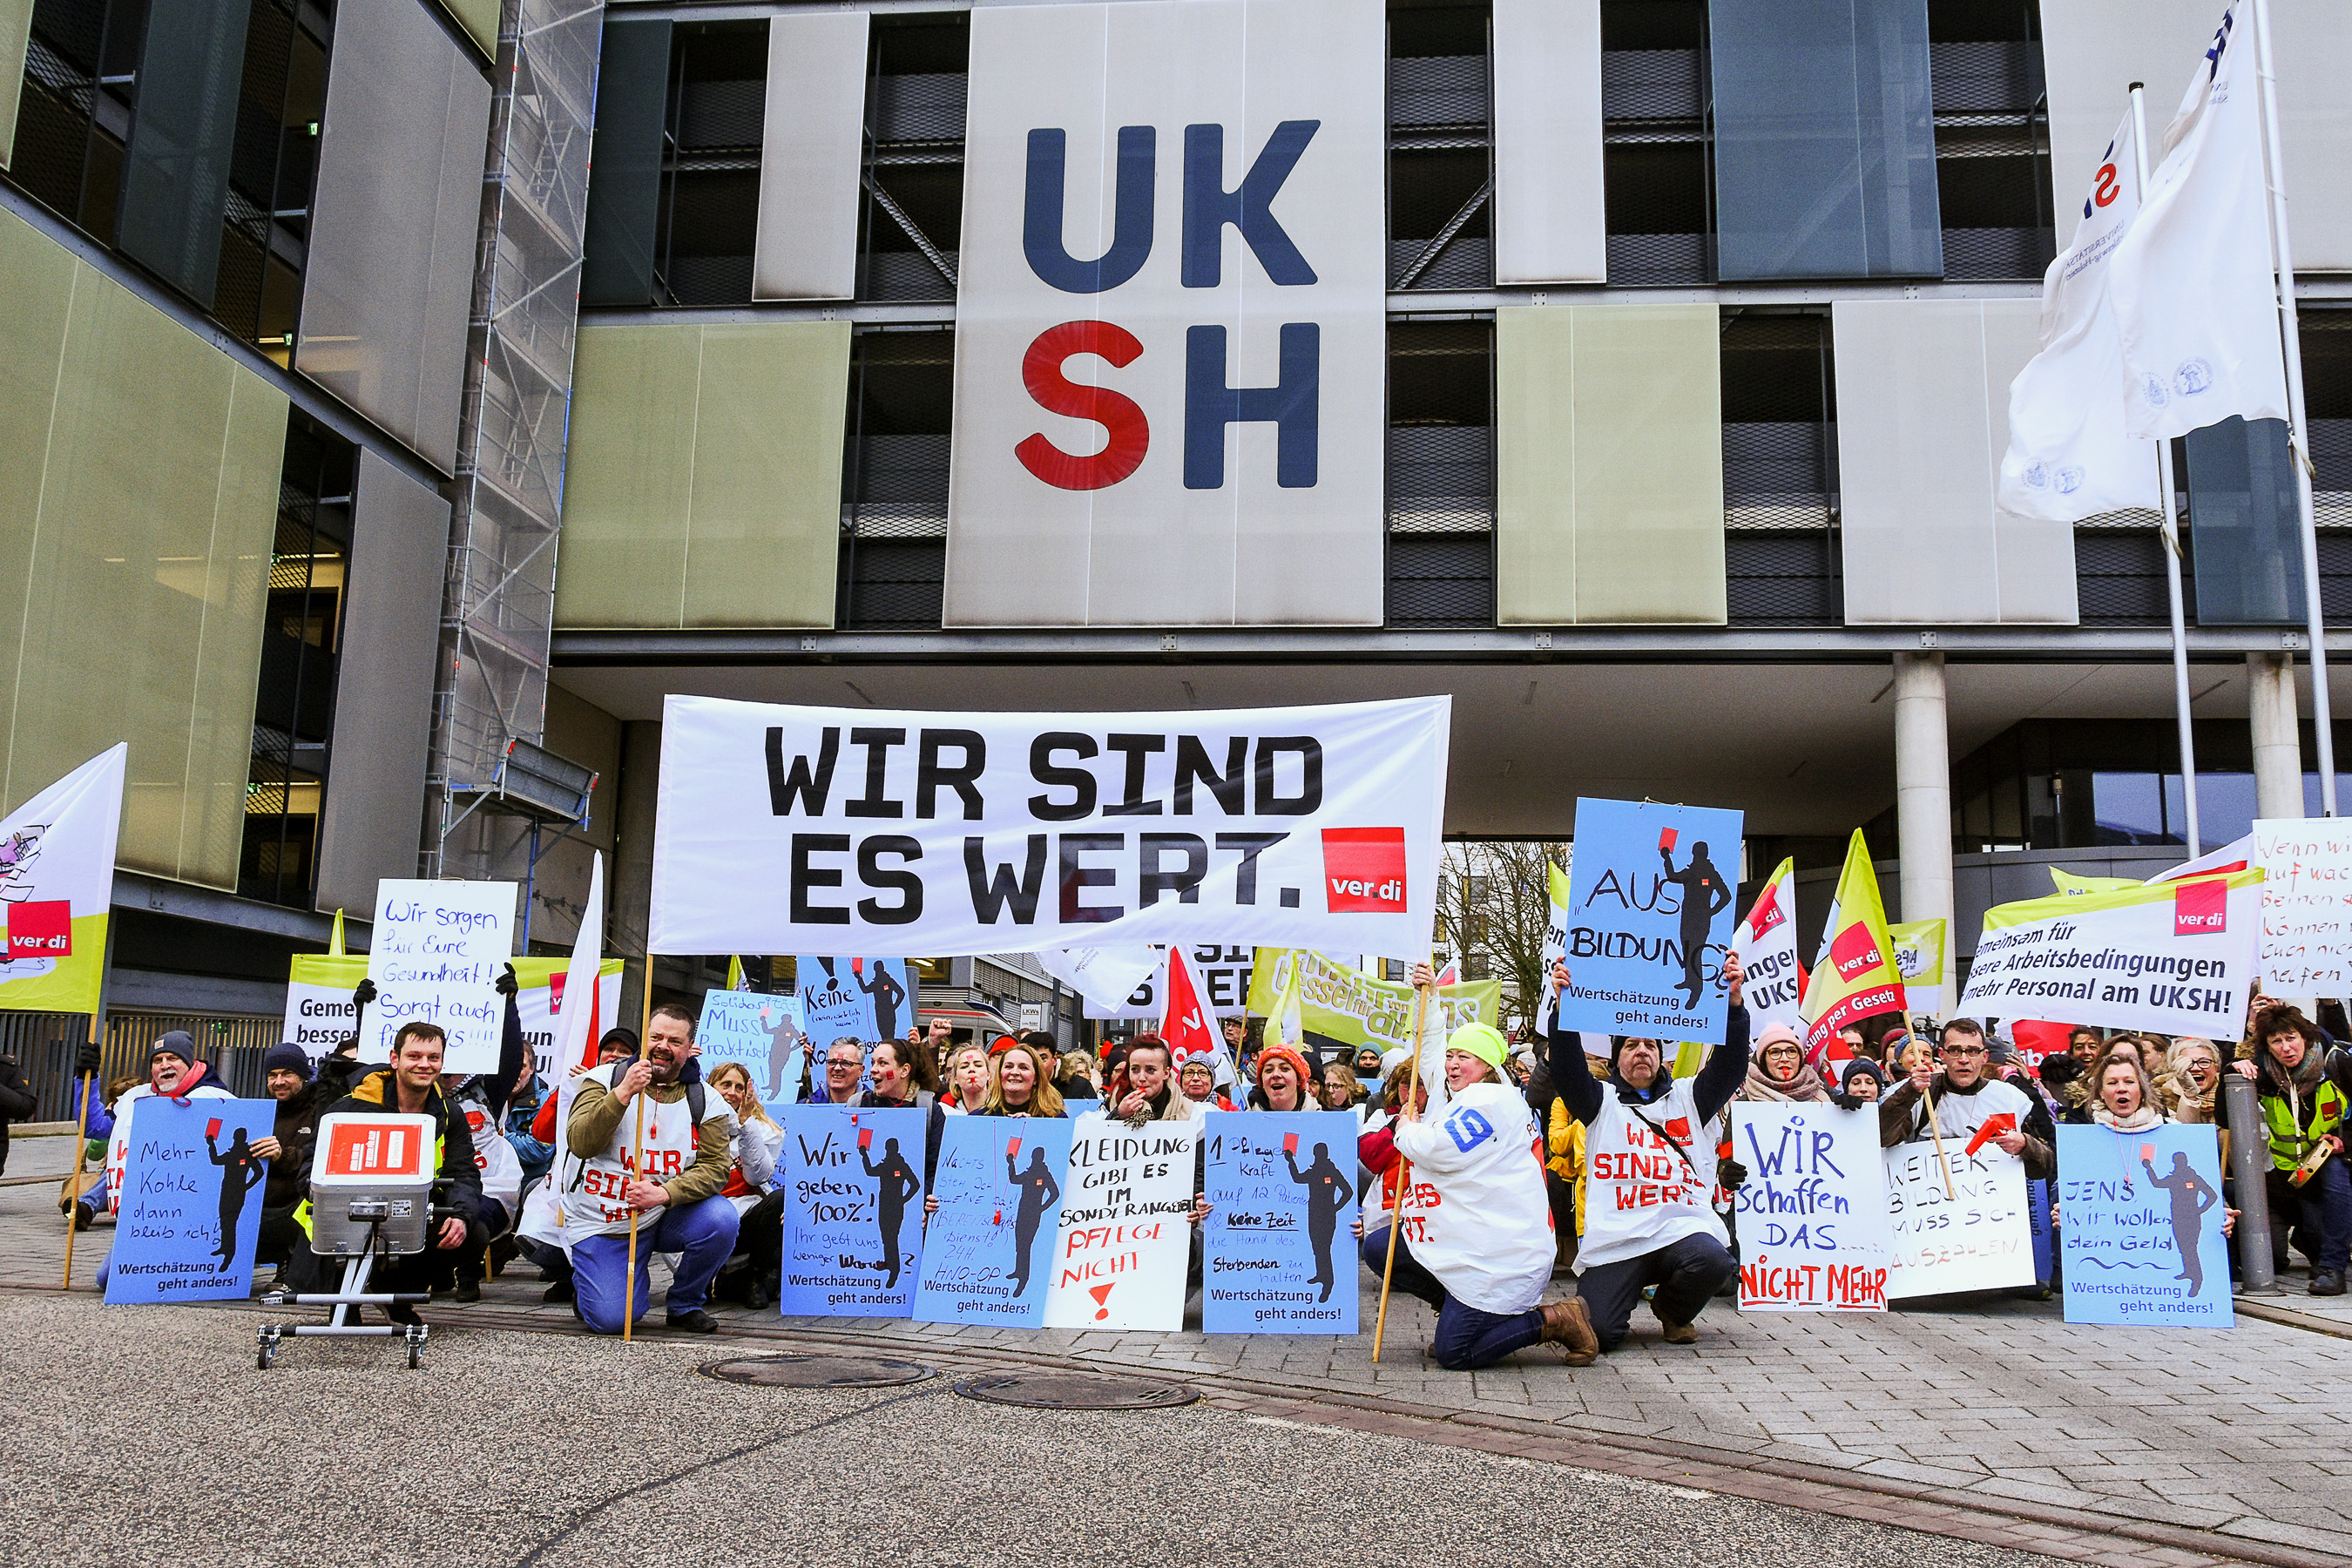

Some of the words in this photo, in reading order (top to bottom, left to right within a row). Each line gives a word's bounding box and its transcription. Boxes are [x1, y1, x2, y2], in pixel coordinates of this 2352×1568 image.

[765, 727, 987, 820] WIR
[1028, 732, 1324, 821] SIND
[2257, 835, 2318, 859] Wenn
[790, 833, 923, 924] ES
[963, 832, 1303, 924] WERT.
[1330, 877, 1402, 903] ver.di
[386, 899, 428, 923] Wir
[436, 908, 497, 935] sorgen
[2178, 912, 2223, 927] ver.di
[2262, 916, 2339, 936] können
[12, 935, 67, 949] ver.di
[382, 929, 413, 954] für
[422, 935, 468, 956] Eure
[2048, 922, 2077, 942] für
[1839, 950, 1880, 973] ver.di
[2003, 948, 2226, 983] Arbeitsbedingungen
[2269, 964, 2341, 988] helfen
[805, 984, 855, 1015] Keine
[1570, 985, 1680, 1010] Wertschätzung
[2005, 978, 2096, 999] Personal
[2102, 983, 2139, 1004] am
[2149, 983, 2231, 1014] UKSH!
[380, 993, 441, 1023] Sorgt
[449, 1001, 495, 1024] auch
[1615, 1010, 1649, 1024] geht
[1653, 1014, 1708, 1029] anders!
[1828, 1004, 1847, 1031] per
[140, 1140, 196, 1163] Mehr
[798, 1132, 852, 1167] Wir
[1083, 1166, 1133, 1189] GIBT
[1143, 1163, 1169, 1179] ES
[1240, 1162, 1275, 1179] Kraft
[1594, 1152, 1673, 1180] SIND
[140, 1167, 198, 1194] Kohle
[796, 1177, 862, 1204] geben
[1107, 1187, 1132, 1206] IM
[1212, 1187, 1243, 1206] auf
[1251, 1186, 1269, 1200] 12
[1887, 1180, 1998, 1213] BILDUNG
[133, 1200, 182, 1220] dann
[1265, 1212, 1297, 1229] Zeit
[1892, 1213, 1950, 1240] MUSS
[794, 1227, 815, 1244] Ihr
[855, 1237, 879, 1249] uns
[1066, 1223, 1169, 1258] PFLEGE
[1207, 1235, 1227, 1248] die
[1236, 1233, 1267, 1246] Hand
[1275, 1233, 1295, 1246] des
[2067, 1234, 2112, 1249] dein
[2119, 1235, 2172, 1251] Geld
[118, 1262, 214, 1276] Wertschätzung
[935, 1262, 1001, 1281] HNO-OP
[1061, 1250, 1146, 1288] NICHT
[1213, 1255, 1281, 1274] Sterbenden
[158, 1279, 187, 1292] geht
[191, 1276, 238, 1288] anders!
[788, 1274, 881, 1289] Wertschätzung
[923, 1280, 1010, 1298] Wertschätzung
[1260, 1273, 1302, 1283] halten
[1828, 1264, 1887, 1304] MEHR
[828, 1292, 856, 1305] geht
[860, 1293, 907, 1304] anders!
[1211, 1289, 1314, 1304] Wertschätzung
[2072, 1282, 2182, 1298] Wertschätzung
[956, 1300, 984, 1313] geht
[986, 1301, 1031, 1315] anders!
[1254, 1307, 1286, 1321] geht
[1289, 1308, 1342, 1321] anders!
[2120, 1300, 2153, 1314] geht
[2159, 1301, 2213, 1314] anders!
